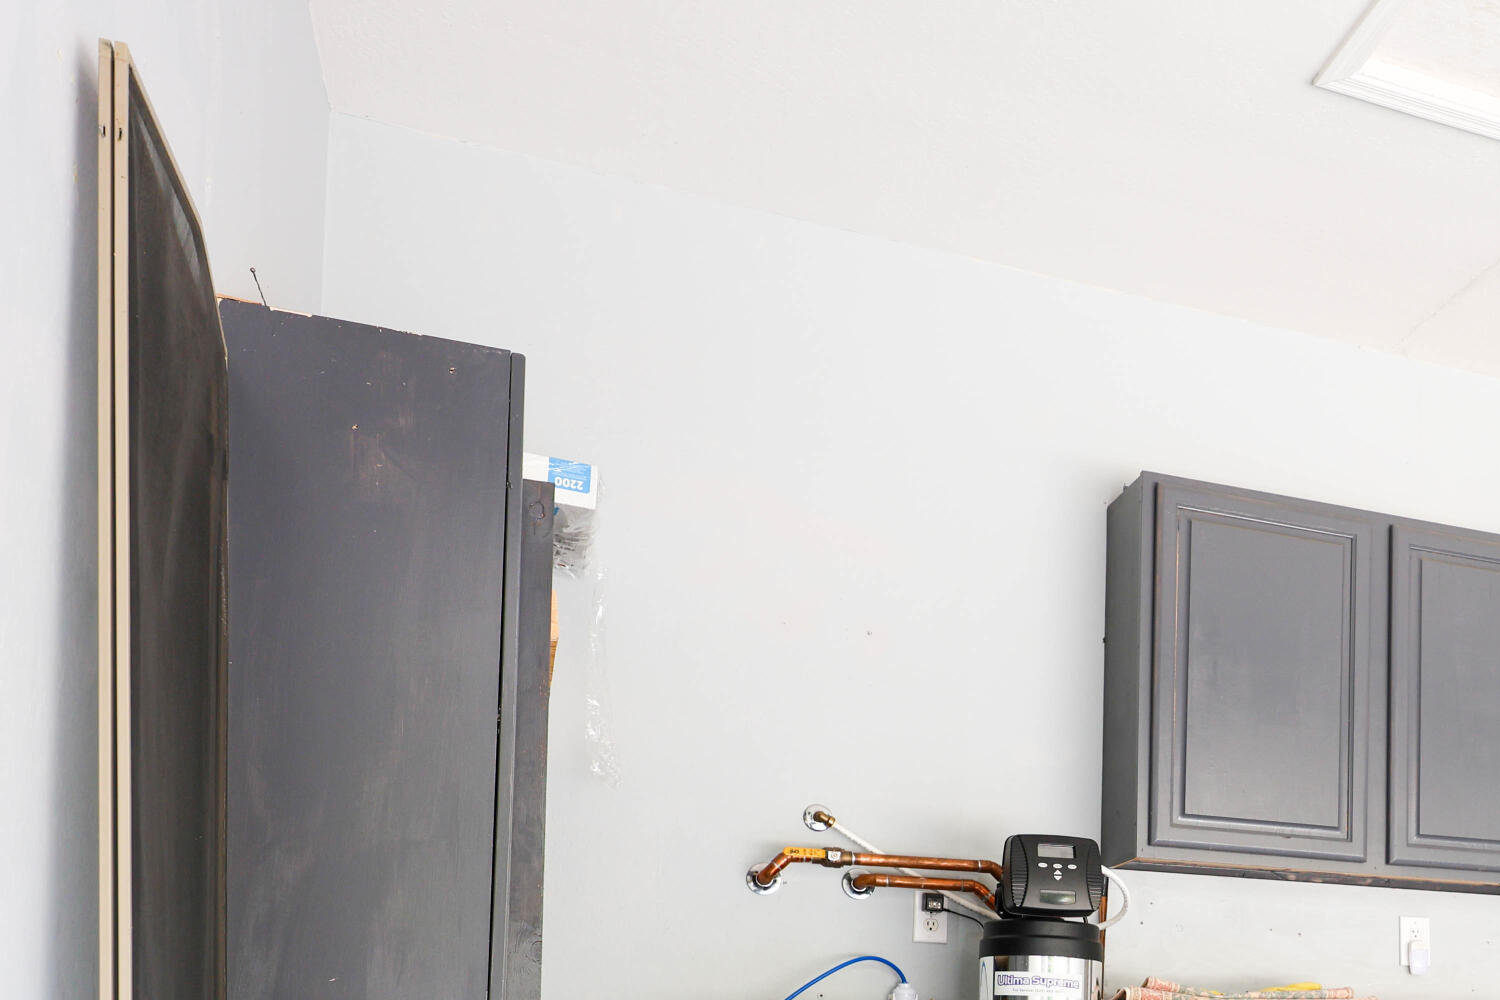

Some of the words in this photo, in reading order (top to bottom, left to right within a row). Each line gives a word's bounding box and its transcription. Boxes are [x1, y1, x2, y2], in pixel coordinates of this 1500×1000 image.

[555, 476, 584, 491] 2200
[997, 974, 1031, 986] Ultima
[1031, 975, 1080, 989] Supreme
